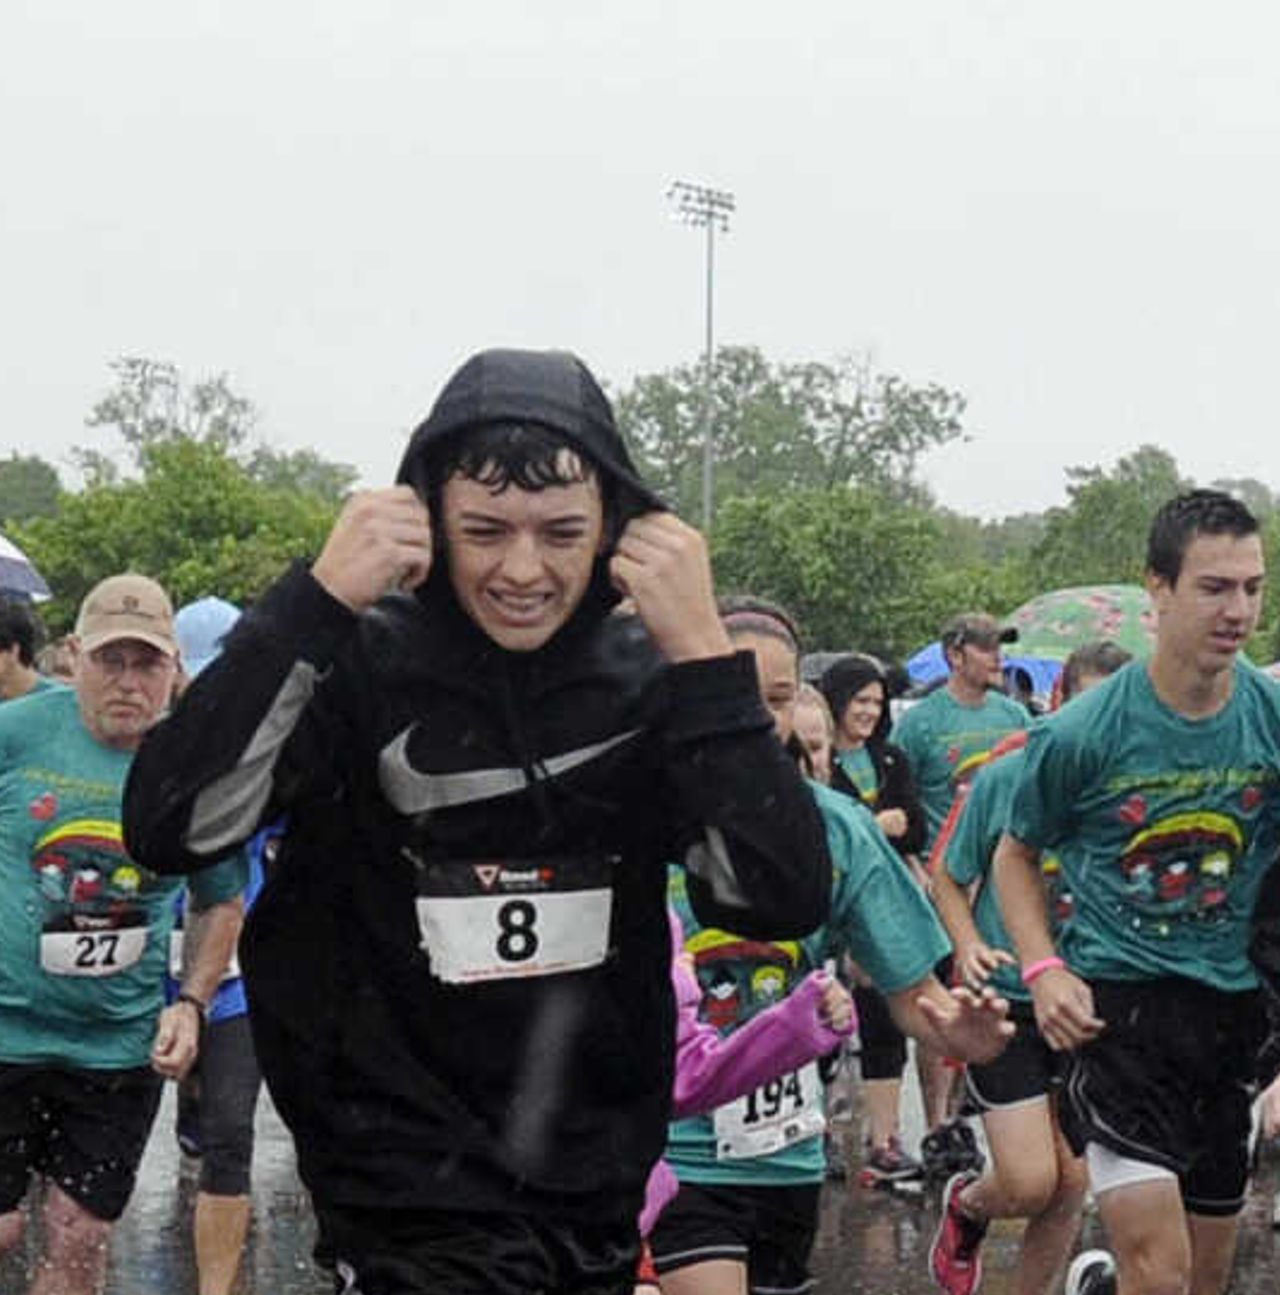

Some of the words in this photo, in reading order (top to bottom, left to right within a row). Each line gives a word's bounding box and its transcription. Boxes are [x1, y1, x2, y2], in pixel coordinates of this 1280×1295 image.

[75, 934, 120, 968] 27
[496, 899, 539, 963] 8
[742, 1066, 805, 1125] 194
